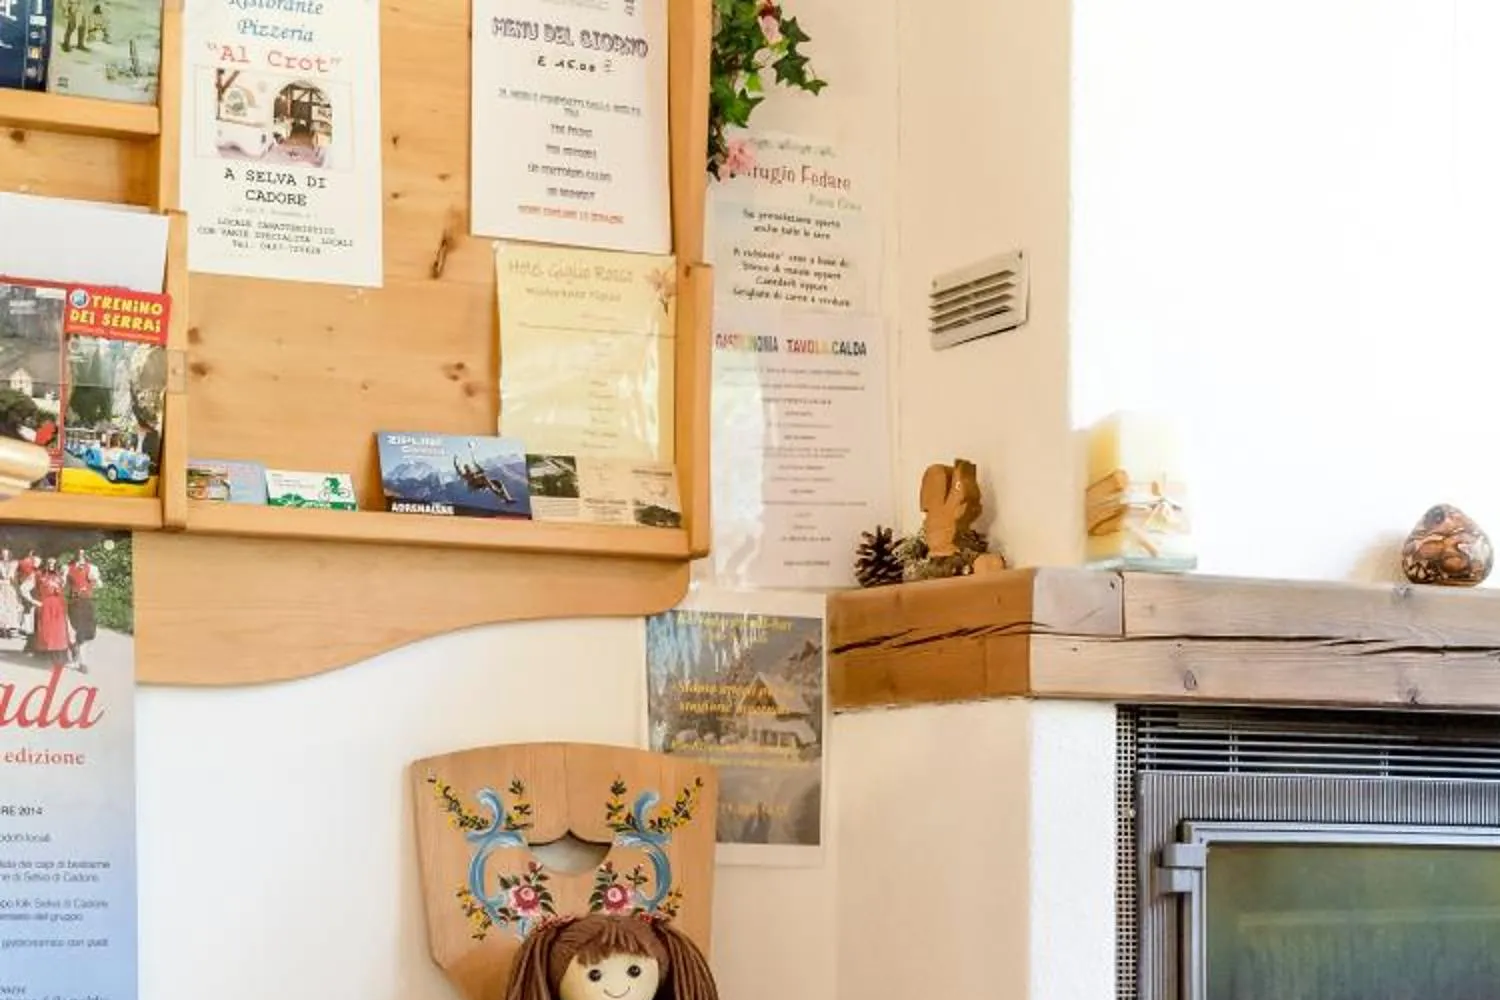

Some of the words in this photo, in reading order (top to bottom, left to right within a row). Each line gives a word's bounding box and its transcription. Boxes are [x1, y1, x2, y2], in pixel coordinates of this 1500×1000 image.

[237, 19, 315, 42] Pizzeria
[492, 16, 539, 41] MENU
[544, 23, 575, 47] DEL
[580, 29, 649, 58] GIORNO
[224, 168, 236, 180] A
[246, 169, 297, 186] SELVA
[307, 175, 327, 190] DI
[801, 165, 852, 190] Fedare
[245, 189, 308, 206] CADORE
[831, 340, 868, 356] CALDA
[4, 746, 87, 765] edizione
[18, 806, 44, 817] 2014
